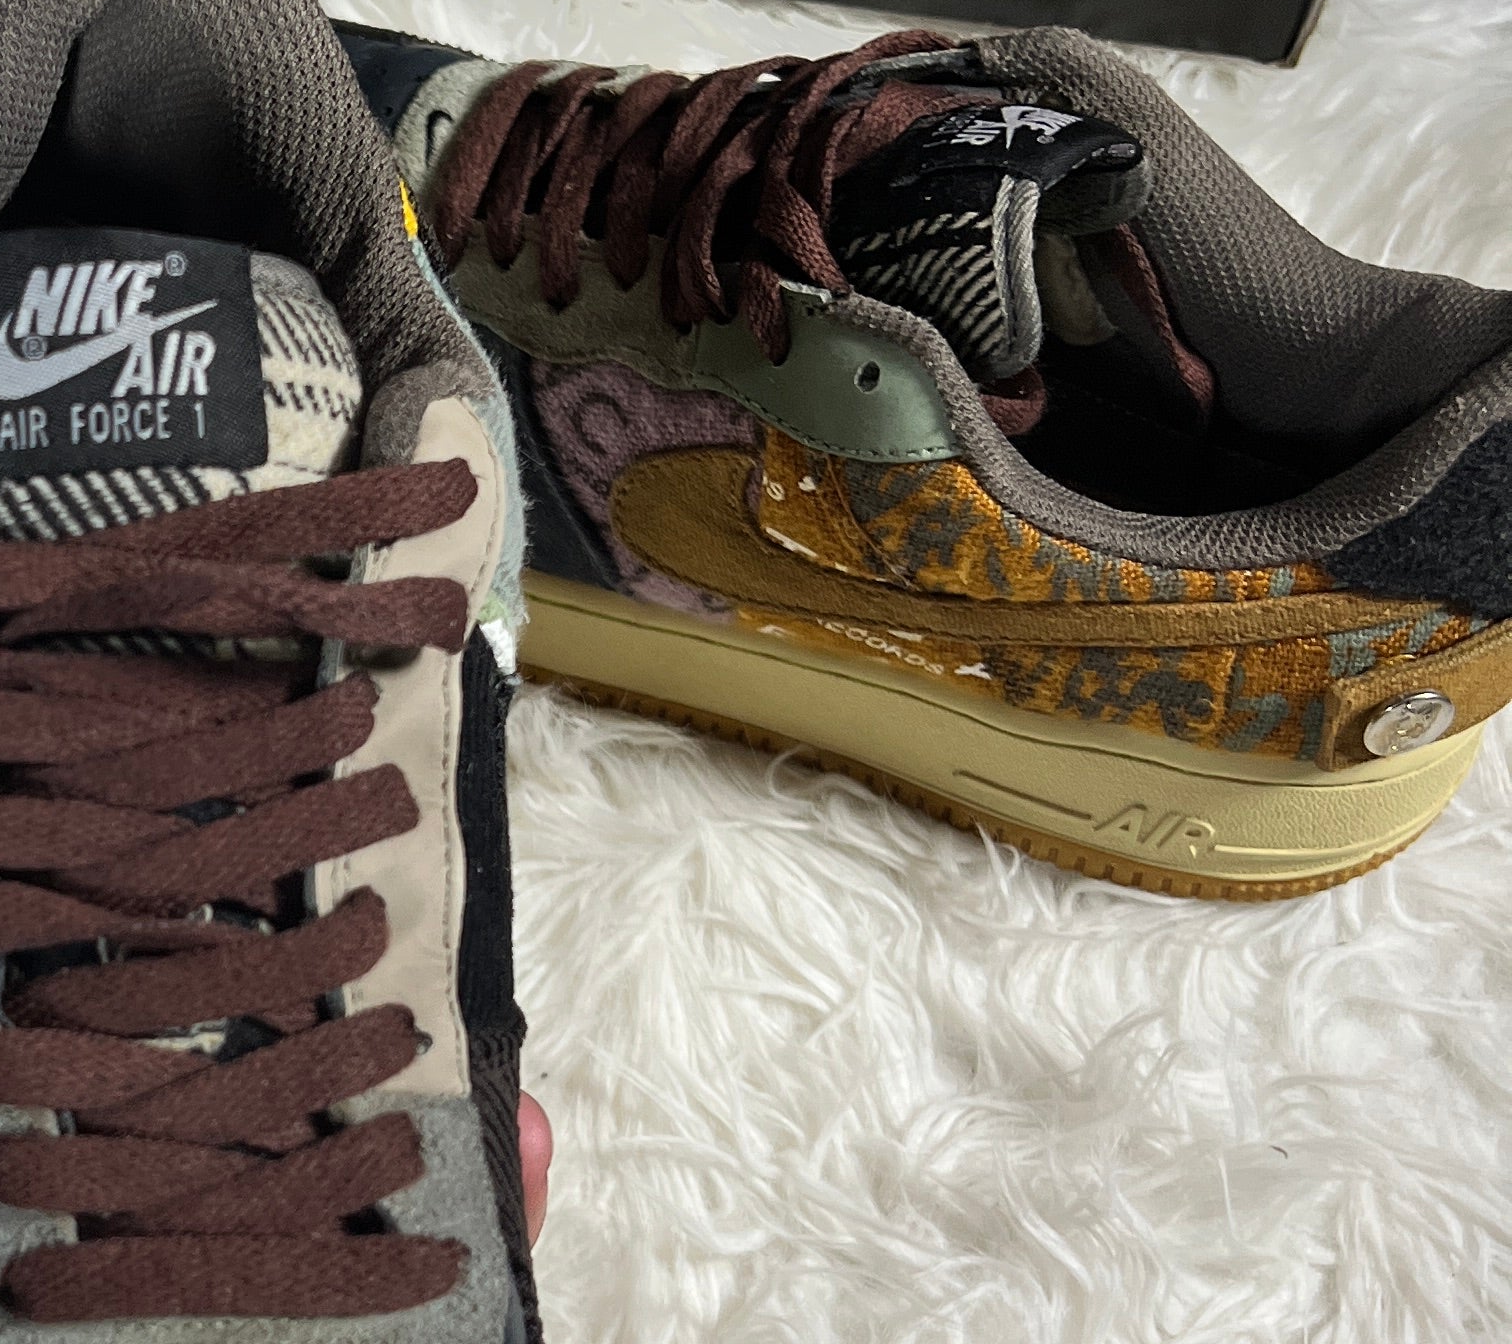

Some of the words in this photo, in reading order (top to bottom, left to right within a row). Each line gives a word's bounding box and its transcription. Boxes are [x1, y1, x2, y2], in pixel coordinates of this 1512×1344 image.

[13, 259, 164, 339] NIKE
[111, 330, 217, 398] AIR
[70, 398, 172, 446] FORCE
[193, 402, 206, 440] 1
[1092, 803, 1217, 858] AIR
